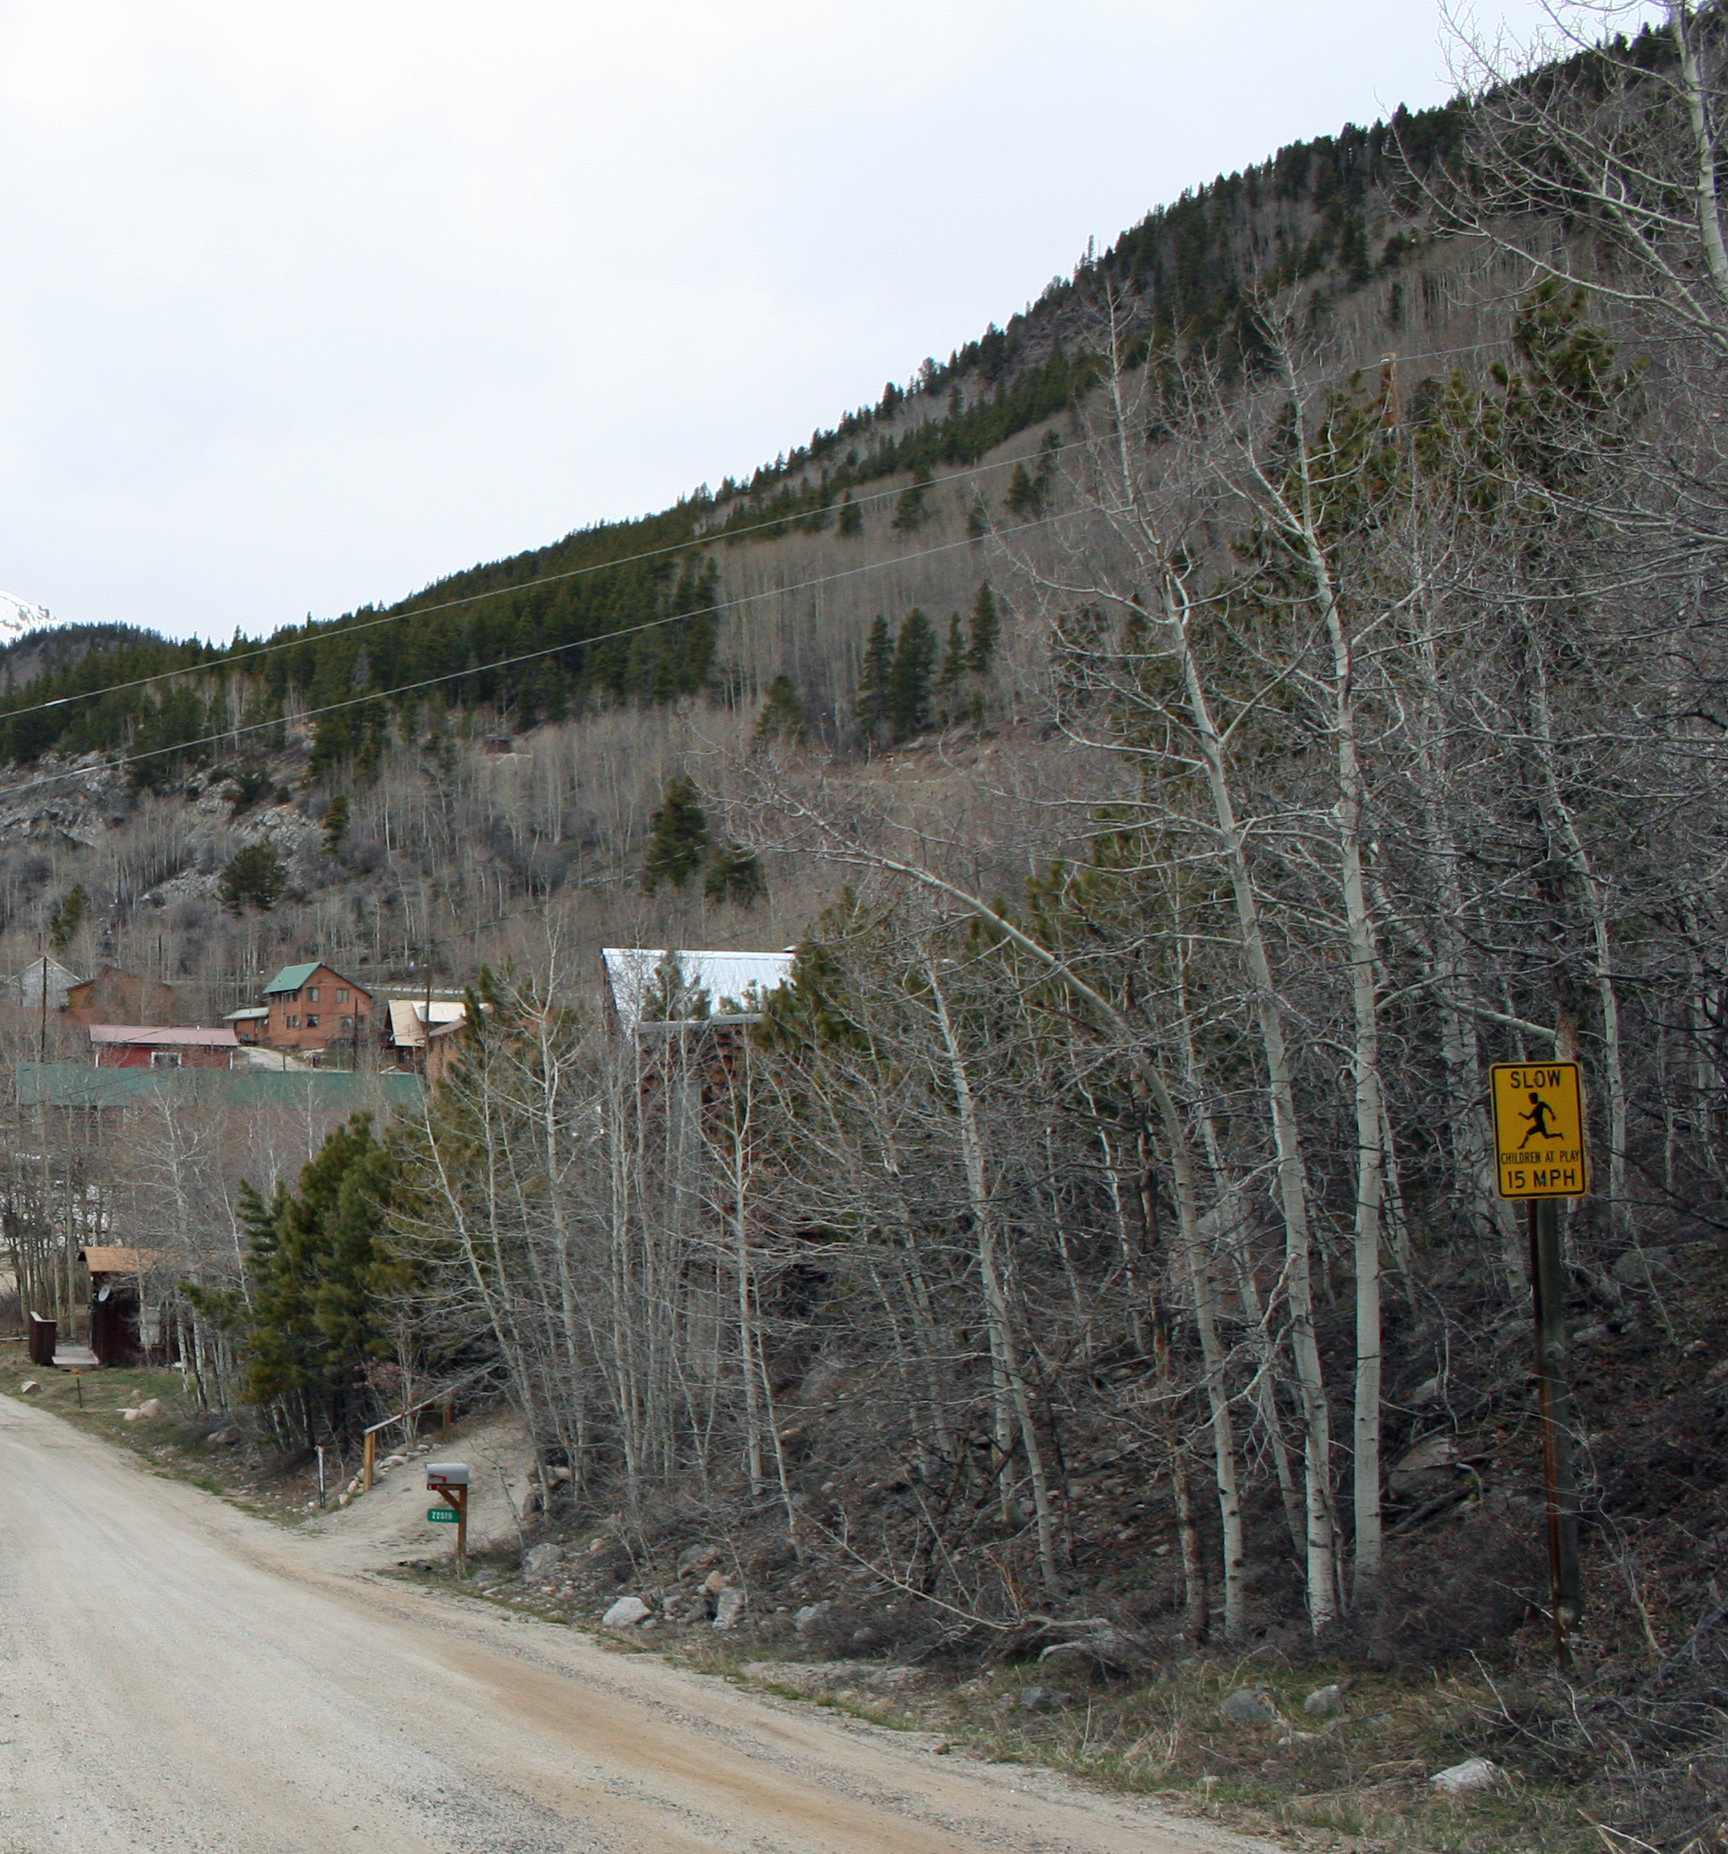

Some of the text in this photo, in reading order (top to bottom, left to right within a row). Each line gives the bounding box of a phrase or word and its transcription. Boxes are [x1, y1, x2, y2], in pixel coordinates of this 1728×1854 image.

[1510, 1070, 1560, 1088] SLOW
[1501, 1150, 1580, 1164] CHILDREN AT PLAY
[1507, 1169, 1574, 1188] 15 MPH
